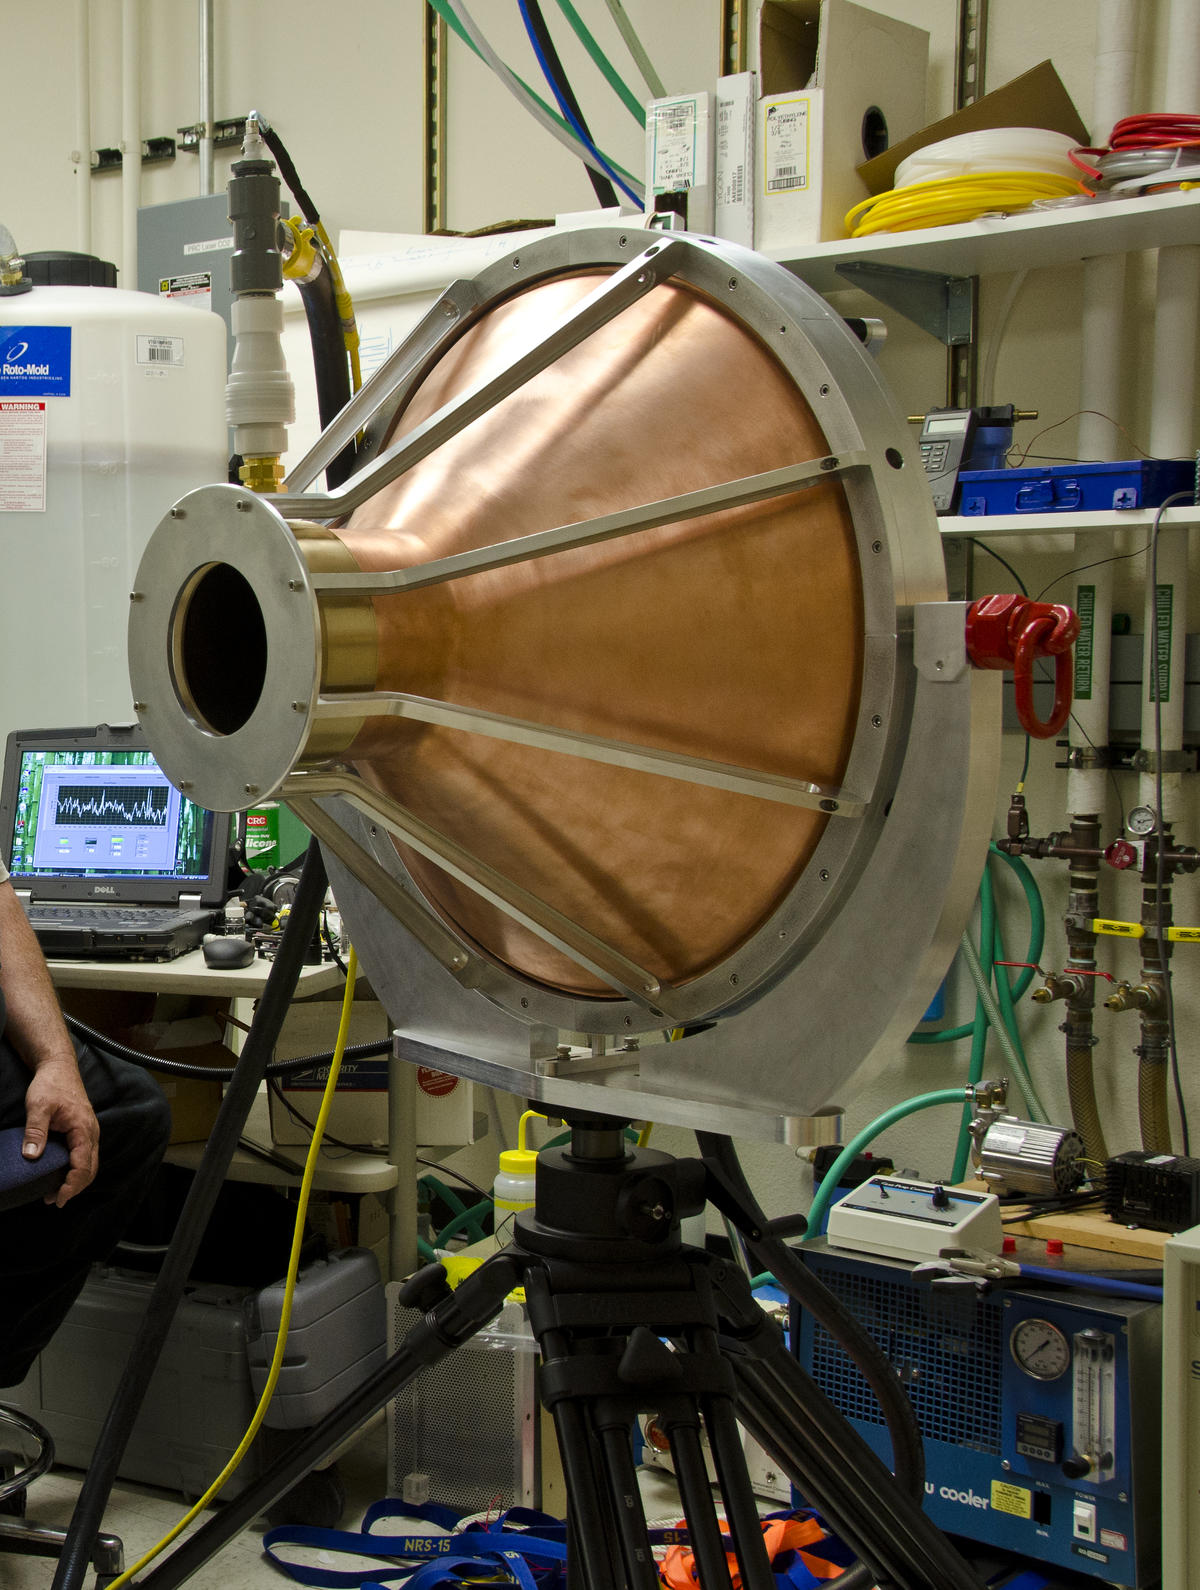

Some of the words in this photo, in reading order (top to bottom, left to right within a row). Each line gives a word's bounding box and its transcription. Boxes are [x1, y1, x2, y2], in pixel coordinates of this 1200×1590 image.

[3, 364, 49, 376] Roto-Mold
[1080, 592, 1093, 626] CHILLED
[1078, 628, 1092, 657] WATER
[1157, 629, 1170, 661] WATER
[1076, 660, 1090, 692] RETURN
[247, 817, 266, 825] CRC
[246, 838, 277, 848] licone
[94, 886, 115, 894] DELL
[939, 1485, 990, 1510] cooler
[1075, 1491, 1096, 1502] POWER
[404, 1539, 451, 1552] NRS-15
